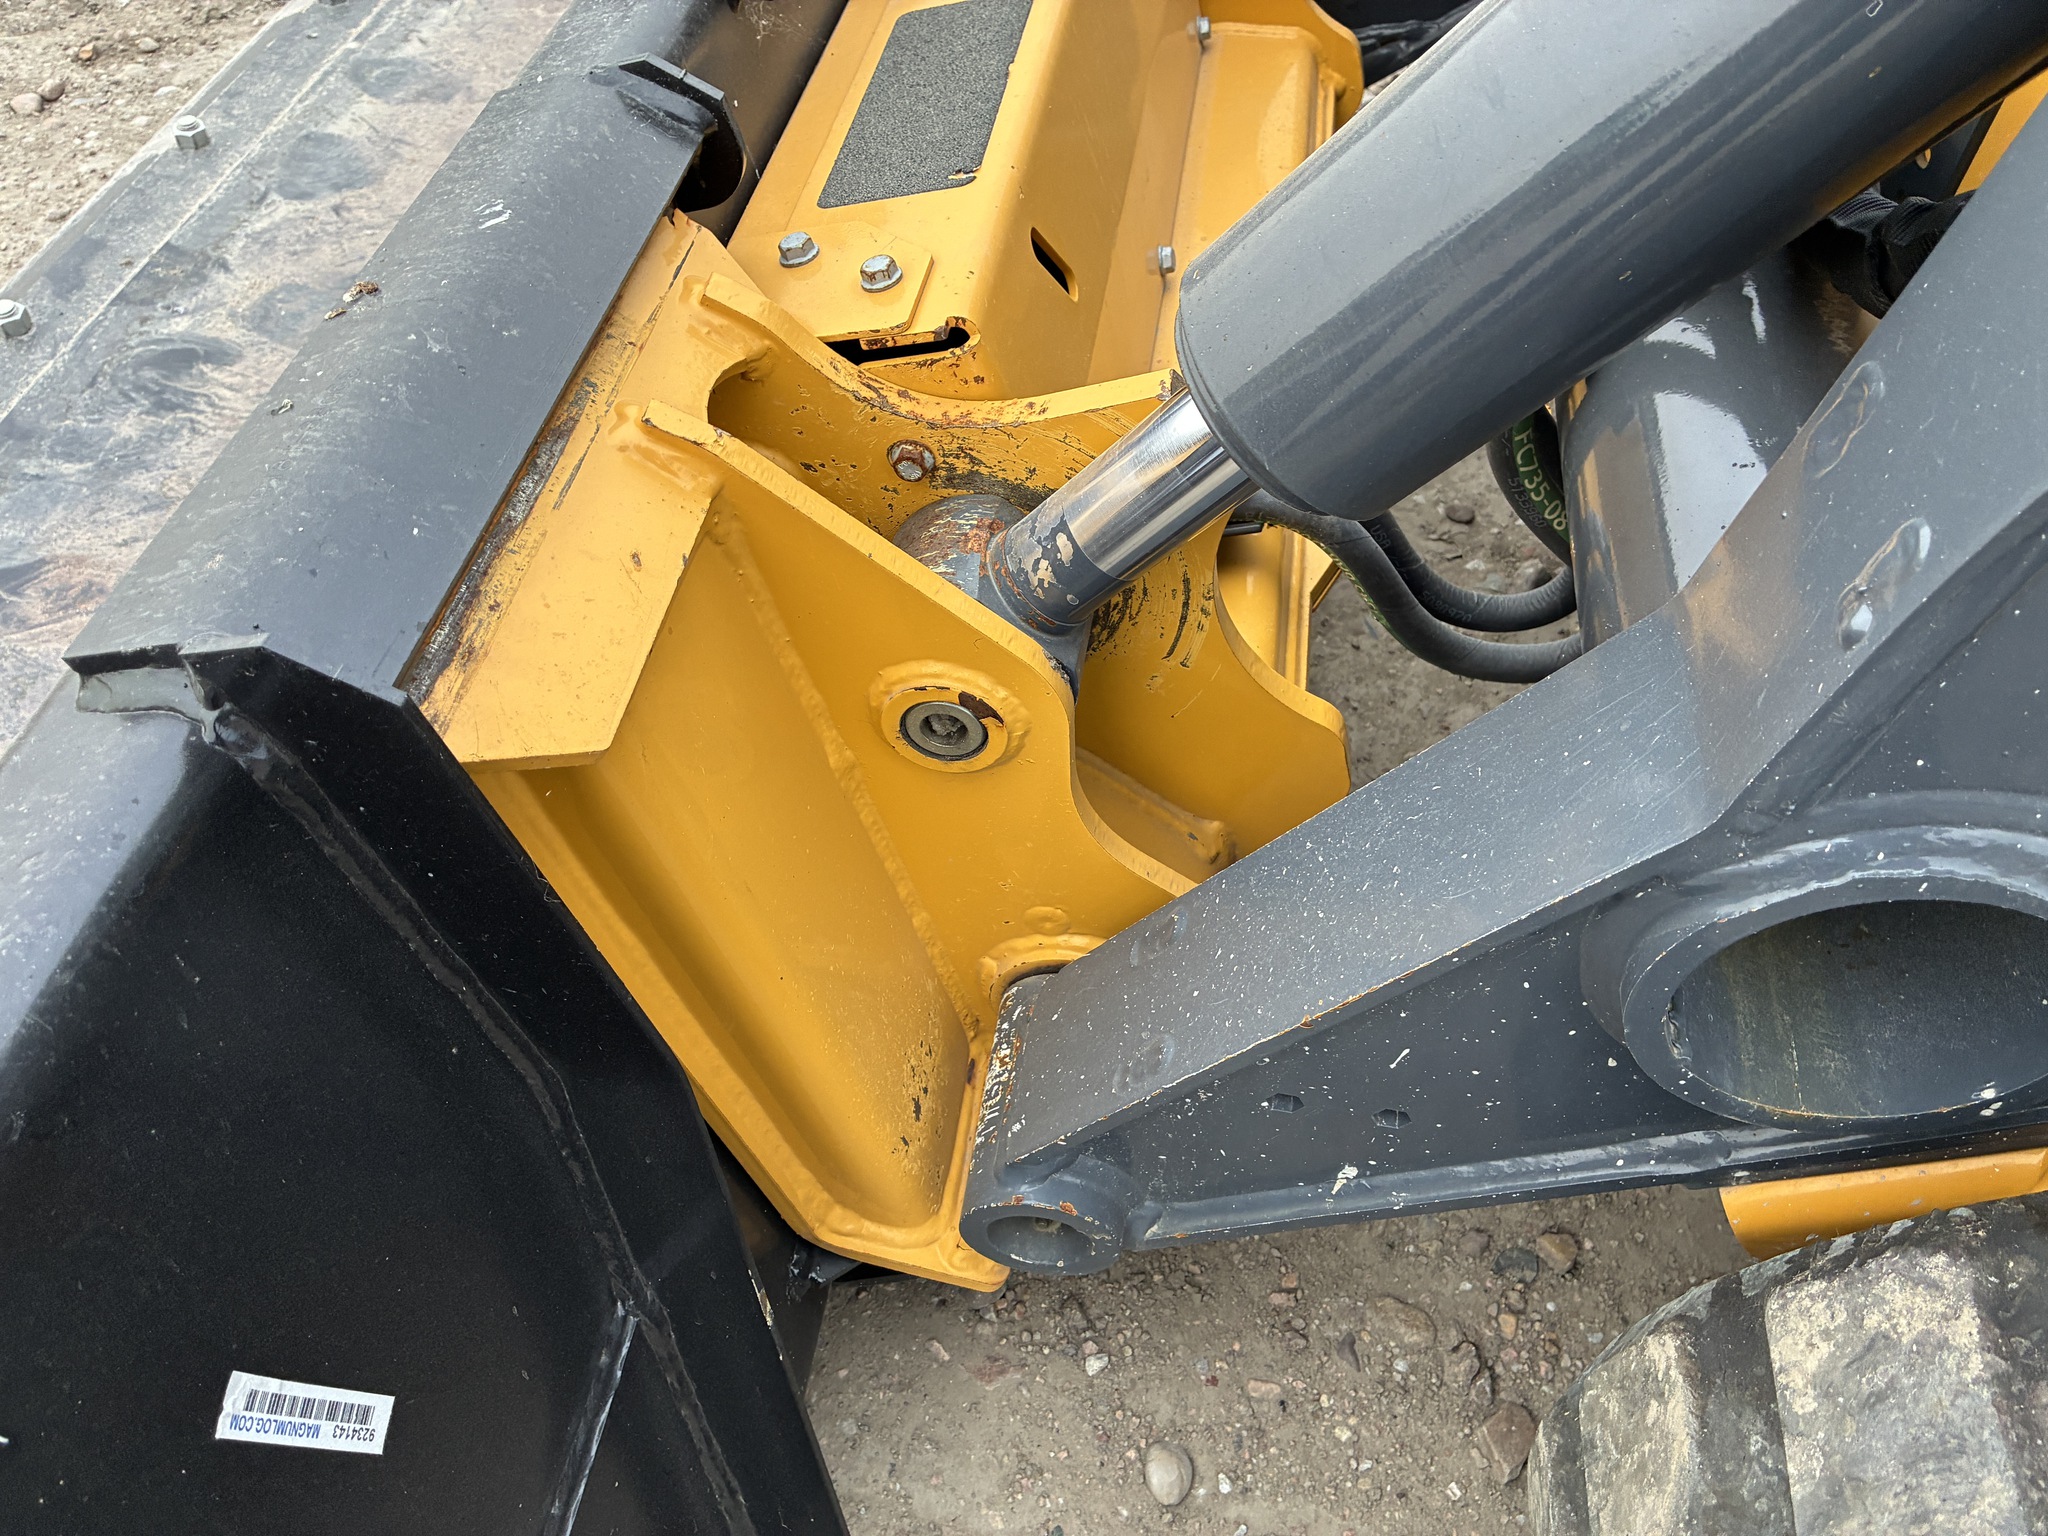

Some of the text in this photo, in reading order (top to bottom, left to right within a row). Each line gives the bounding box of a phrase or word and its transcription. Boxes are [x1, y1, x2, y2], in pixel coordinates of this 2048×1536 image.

[1514, 427, 1568, 530] FC735-08
[229, 1413, 376, 1442] 9234143 MAGNUMLOG.COM
